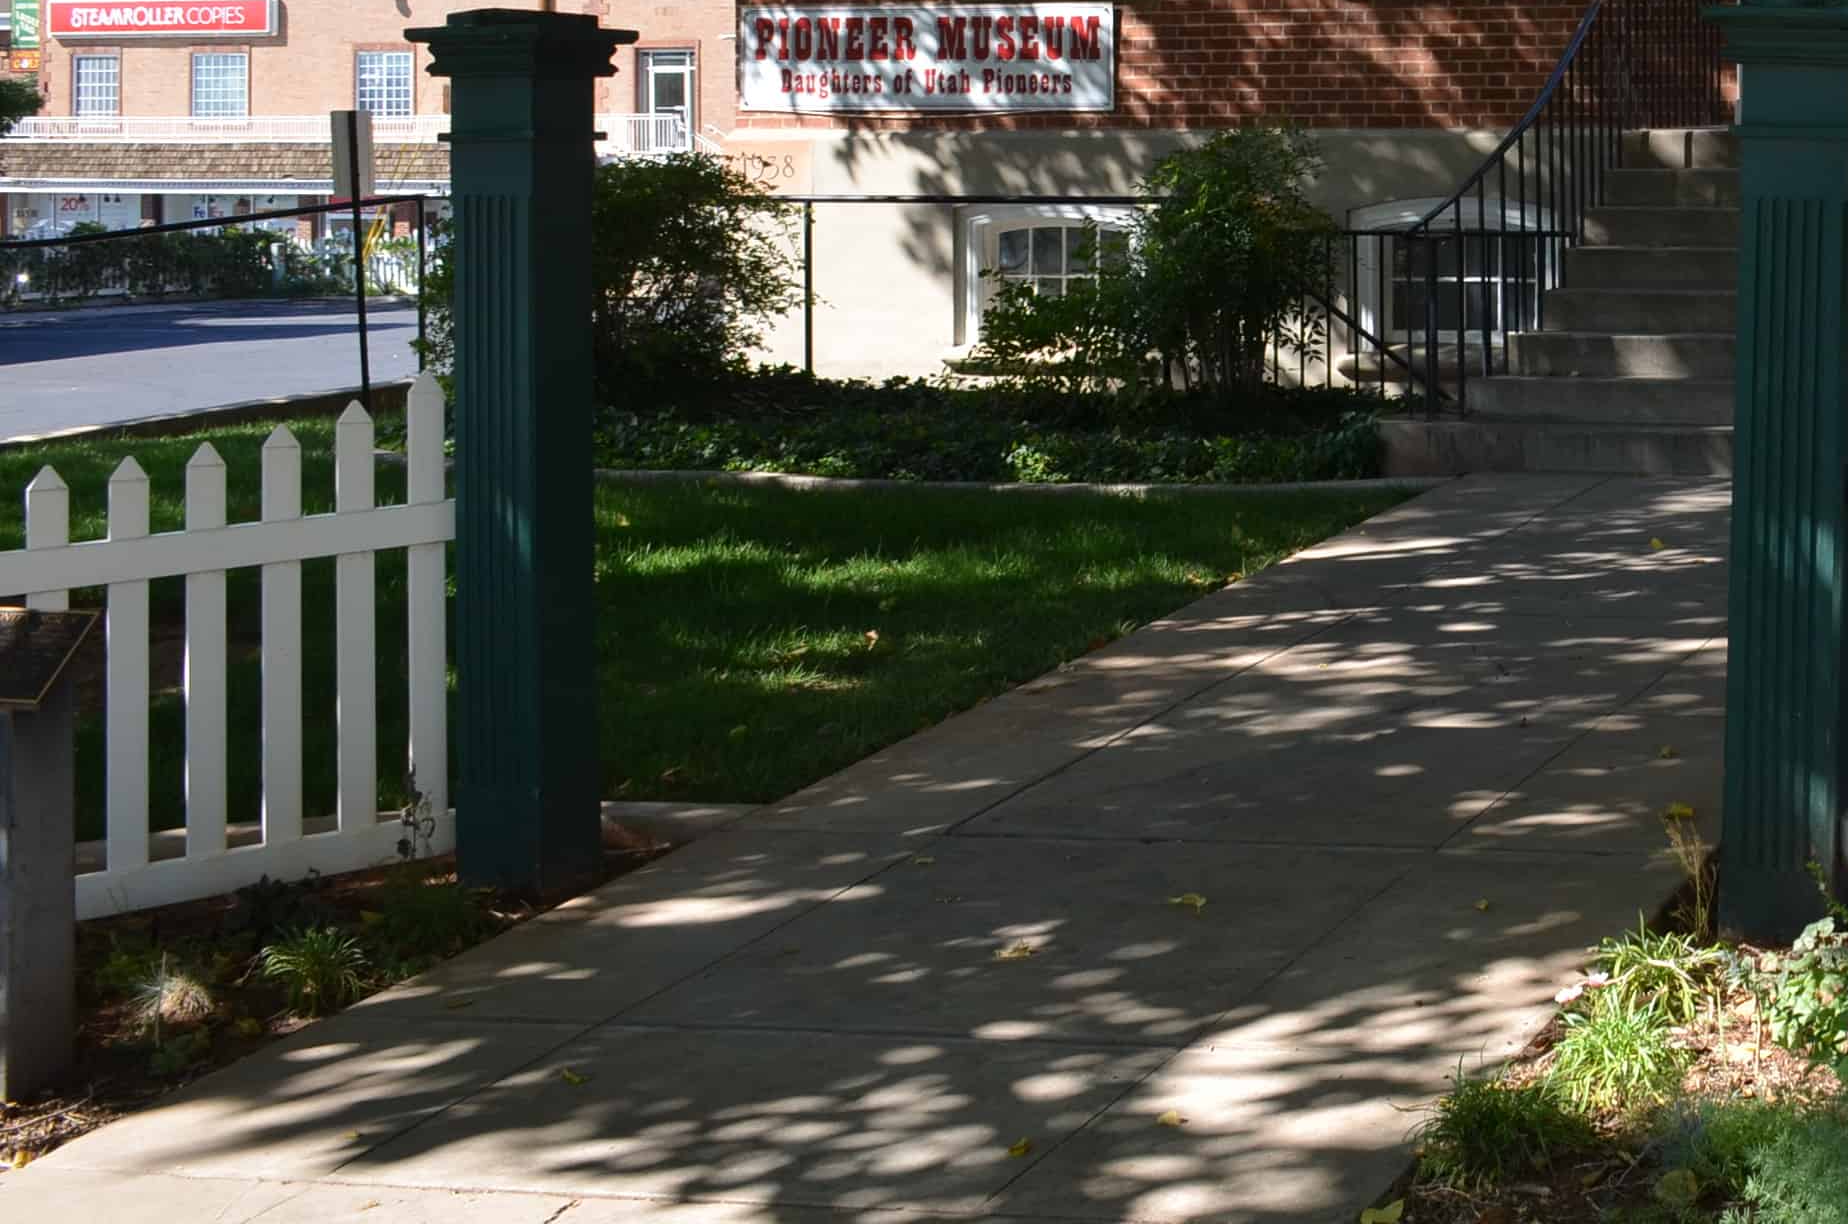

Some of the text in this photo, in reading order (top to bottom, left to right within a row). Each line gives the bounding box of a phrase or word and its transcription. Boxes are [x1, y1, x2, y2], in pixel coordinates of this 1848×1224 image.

[71, 6, 245, 28] STEAMROLLER COPIES
[754, 15, 1102, 62] PIONEER MUSEUM
[781, 68, 1073, 99] Daughters of Utah Pioneers
[743, 154, 794, 182] 1938
